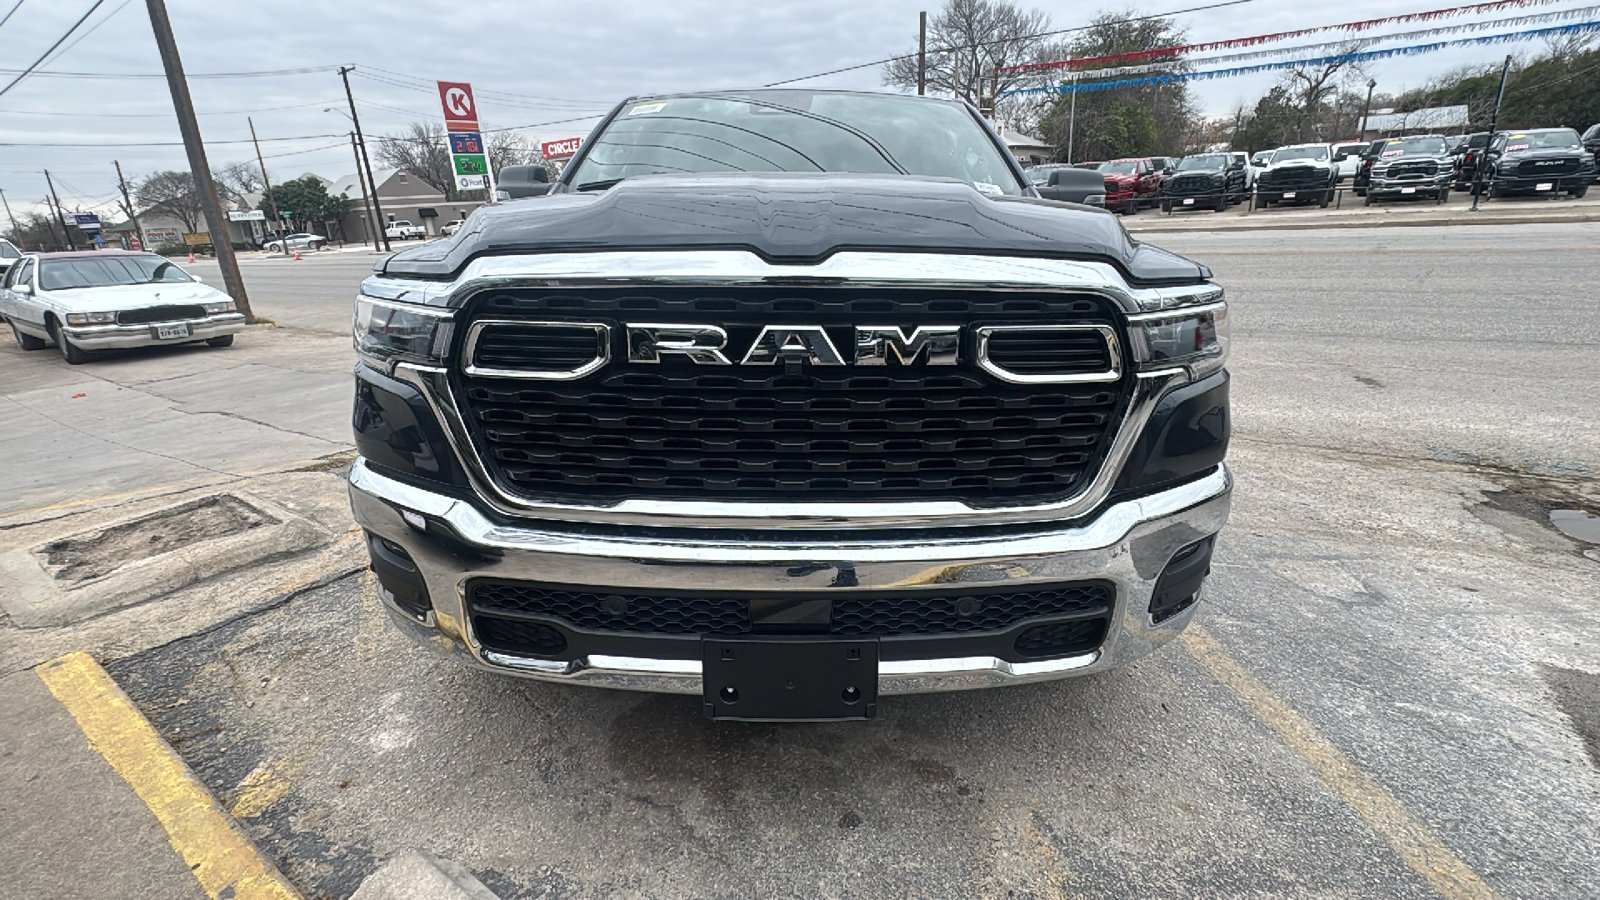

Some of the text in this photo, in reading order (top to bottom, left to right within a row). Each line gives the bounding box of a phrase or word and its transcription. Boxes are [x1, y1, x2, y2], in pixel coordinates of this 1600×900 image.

[449, 91, 471, 114] K
[547, 140, 578, 155] CIRCLE
[626, 322, 962, 366] RAM
